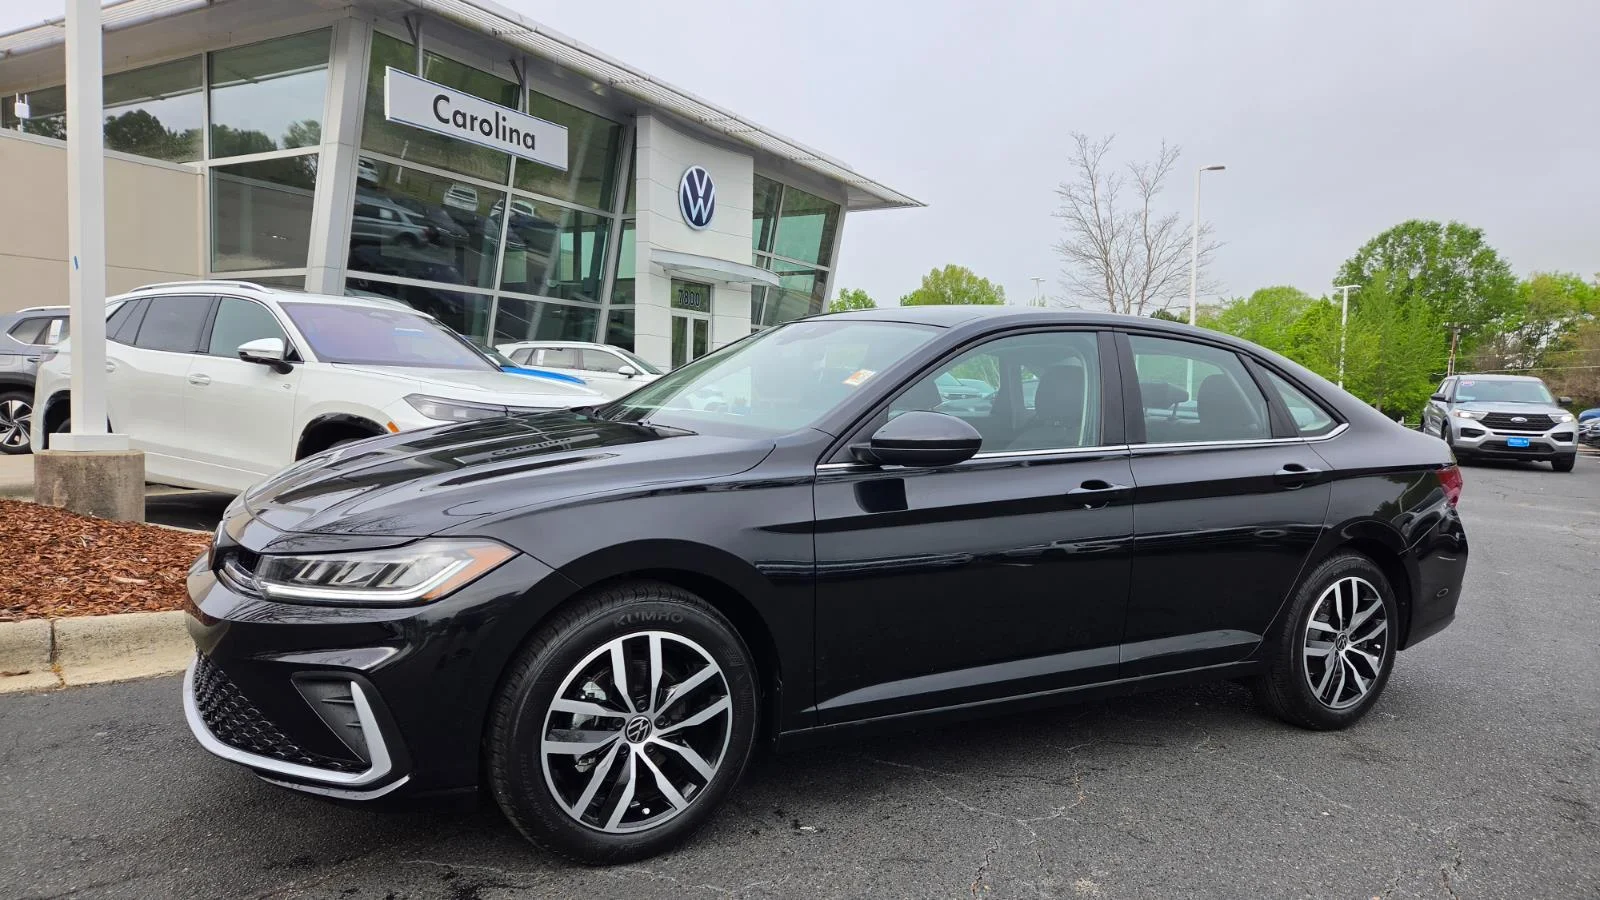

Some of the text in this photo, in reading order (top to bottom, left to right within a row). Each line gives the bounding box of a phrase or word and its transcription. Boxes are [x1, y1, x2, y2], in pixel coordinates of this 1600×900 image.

[433, 94, 536, 150] Carolina
[678, 289, 701, 306] 7800
[614, 611, 684, 627] KUMHO
